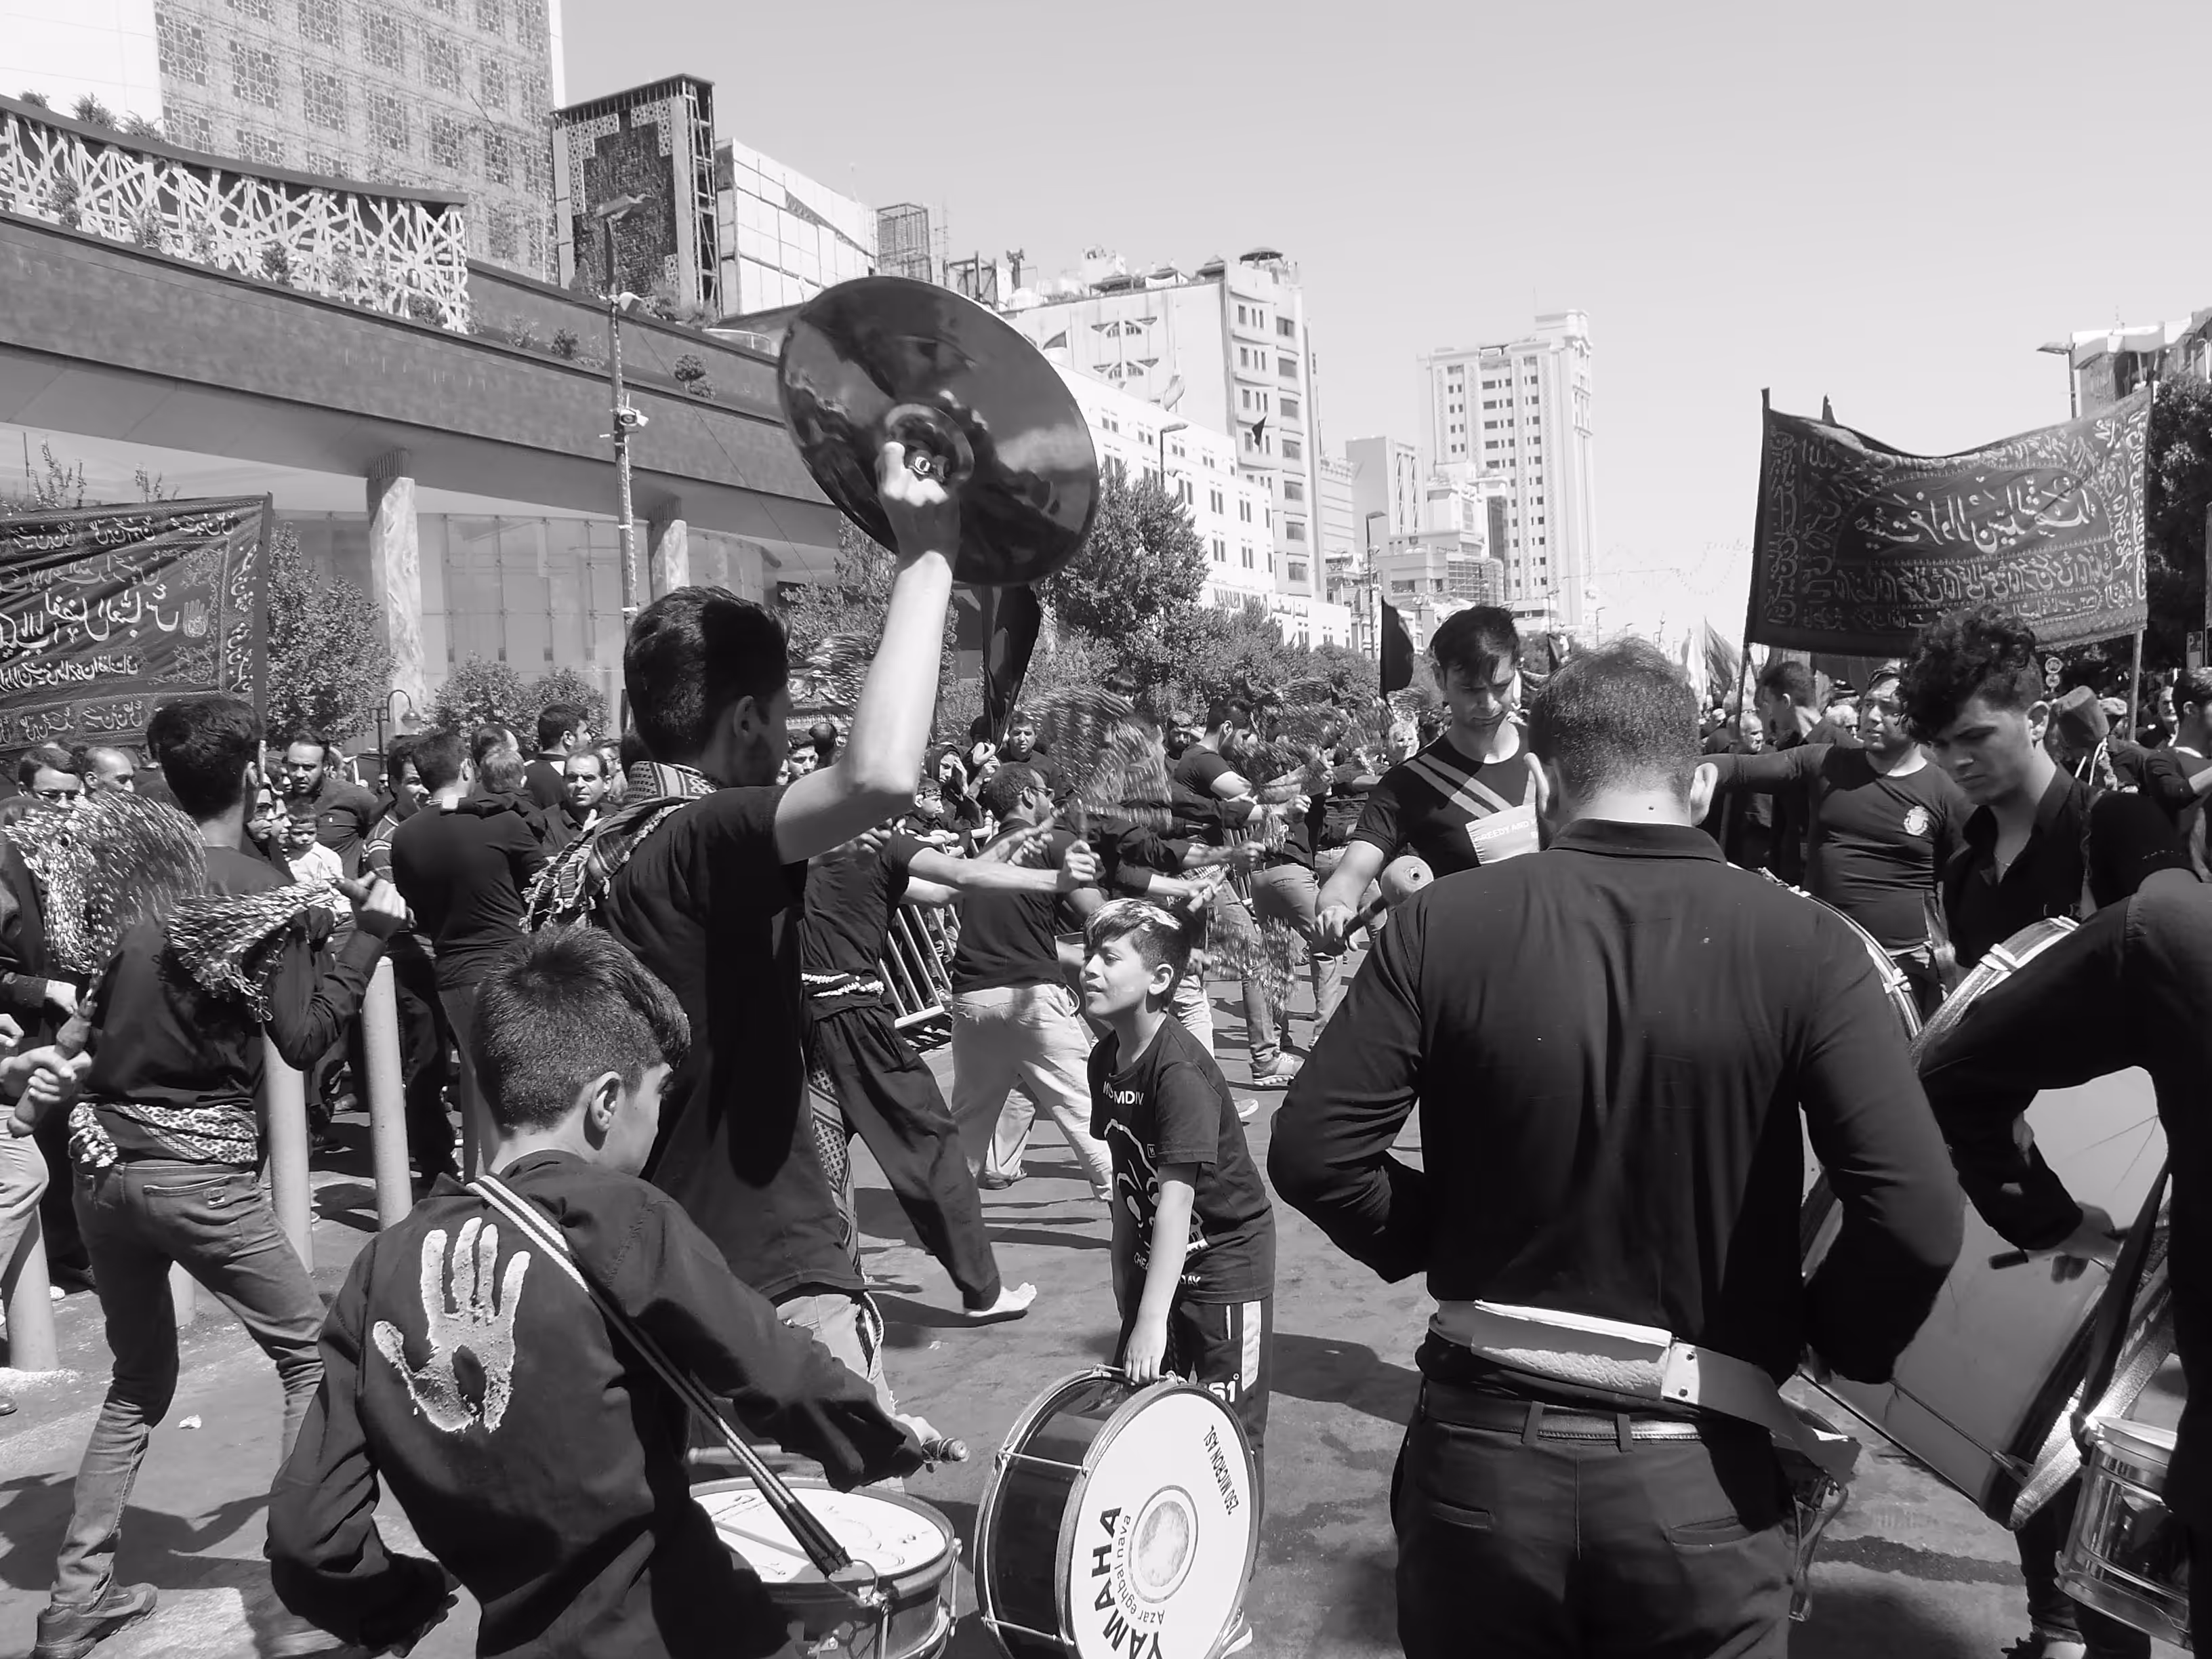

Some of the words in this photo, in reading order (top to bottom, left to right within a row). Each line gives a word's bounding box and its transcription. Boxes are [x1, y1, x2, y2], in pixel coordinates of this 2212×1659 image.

[1204, 1425, 1219, 1452] ASL
[1210, 1446, 1233, 1496] MICRON
[1117, 1515, 1131, 1558] nava
[1092, 1507, 1163, 1659] YAMAHA
[1115, 1563, 1137, 1614] eghbal
[1137, 1610, 1165, 1625] Azar
